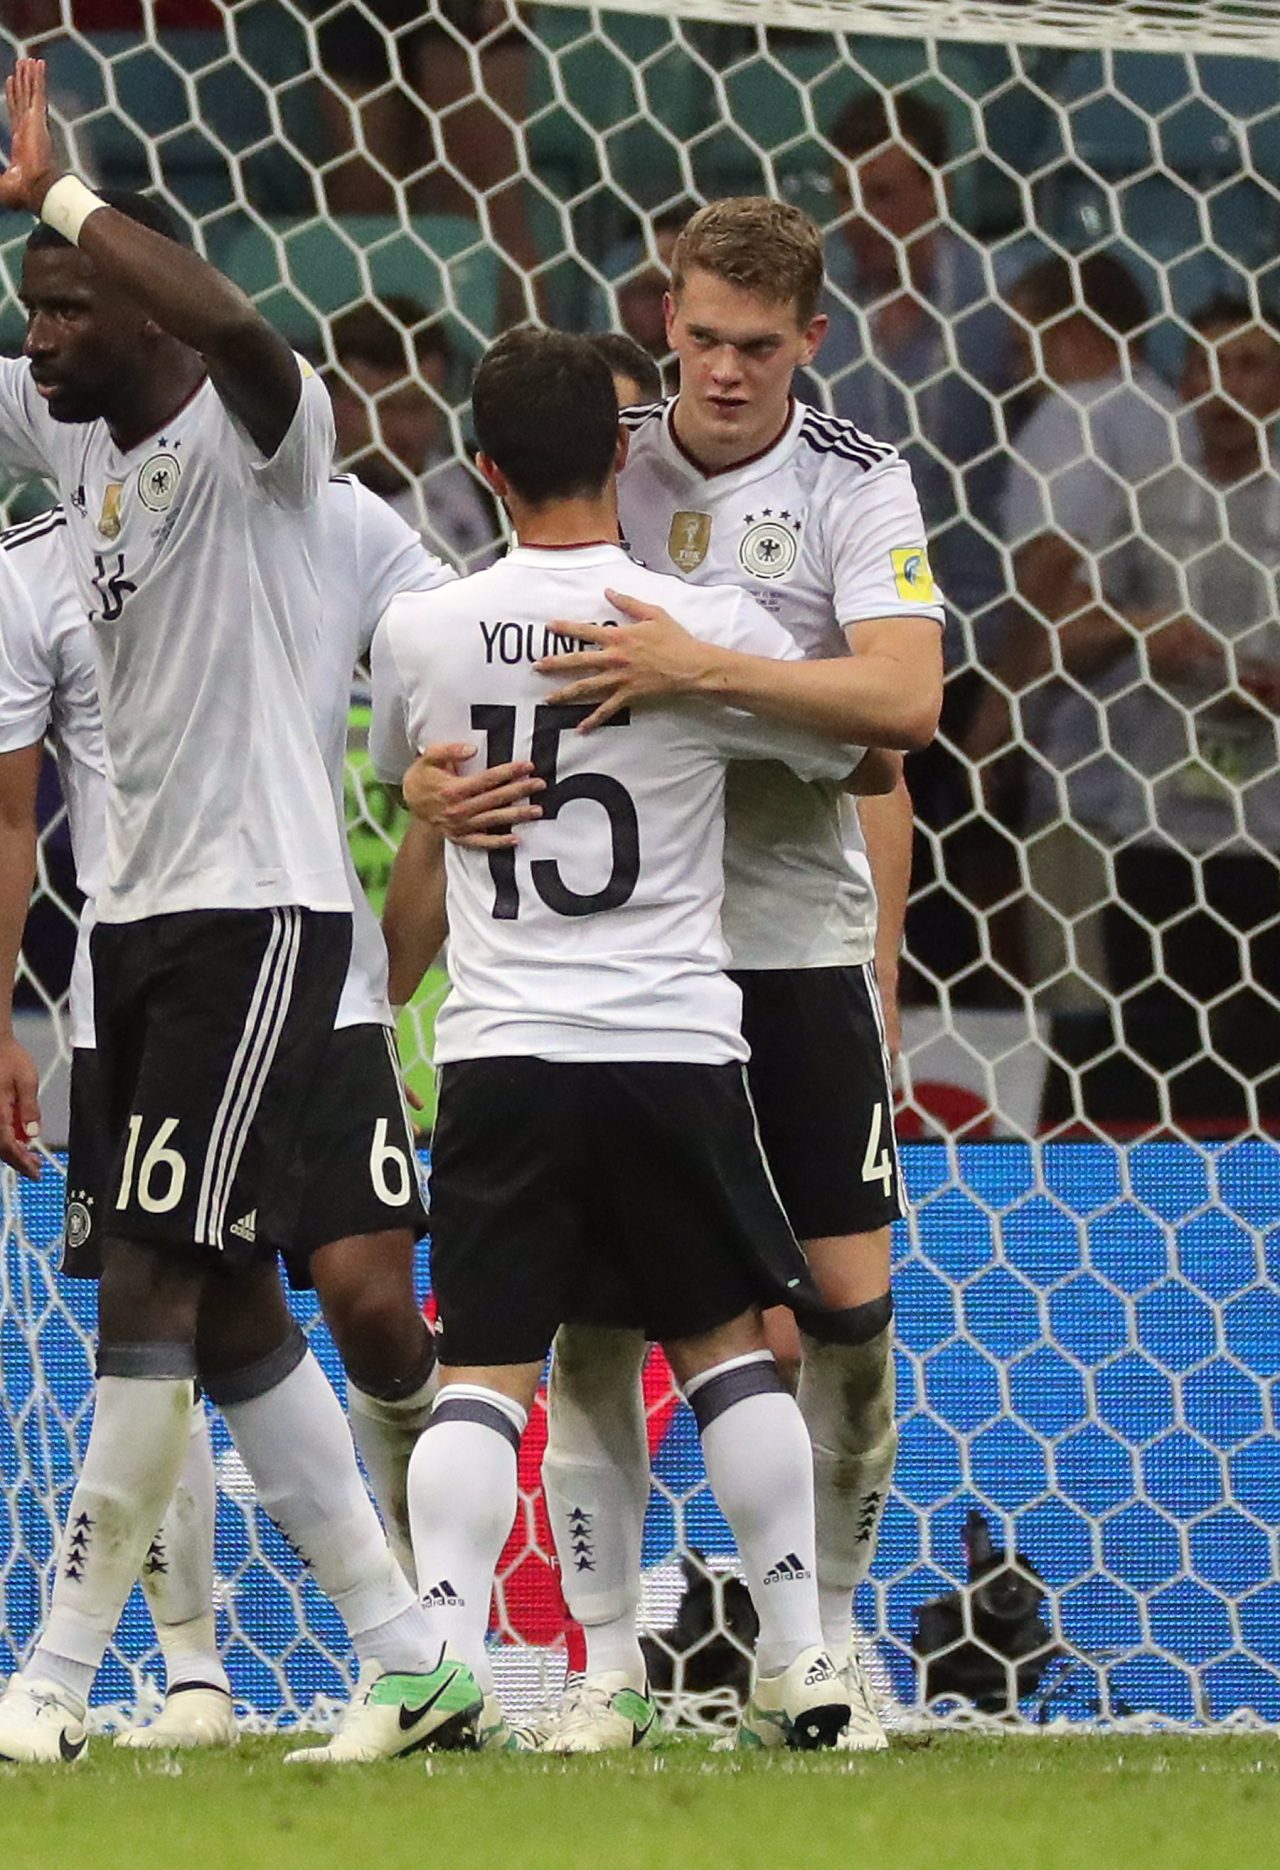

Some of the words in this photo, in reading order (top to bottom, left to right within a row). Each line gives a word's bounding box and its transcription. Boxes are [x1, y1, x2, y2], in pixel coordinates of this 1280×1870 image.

[479, 620, 619, 664] YOUN
[471, 704, 640, 920] 15
[115, 1114, 186, 1213] 16
[369, 1118, 411, 1207] 6
[862, 1103, 893, 1197] 4
[763, 1571, 811, 1585] adidas
[804, 1671, 832, 1686] adi
